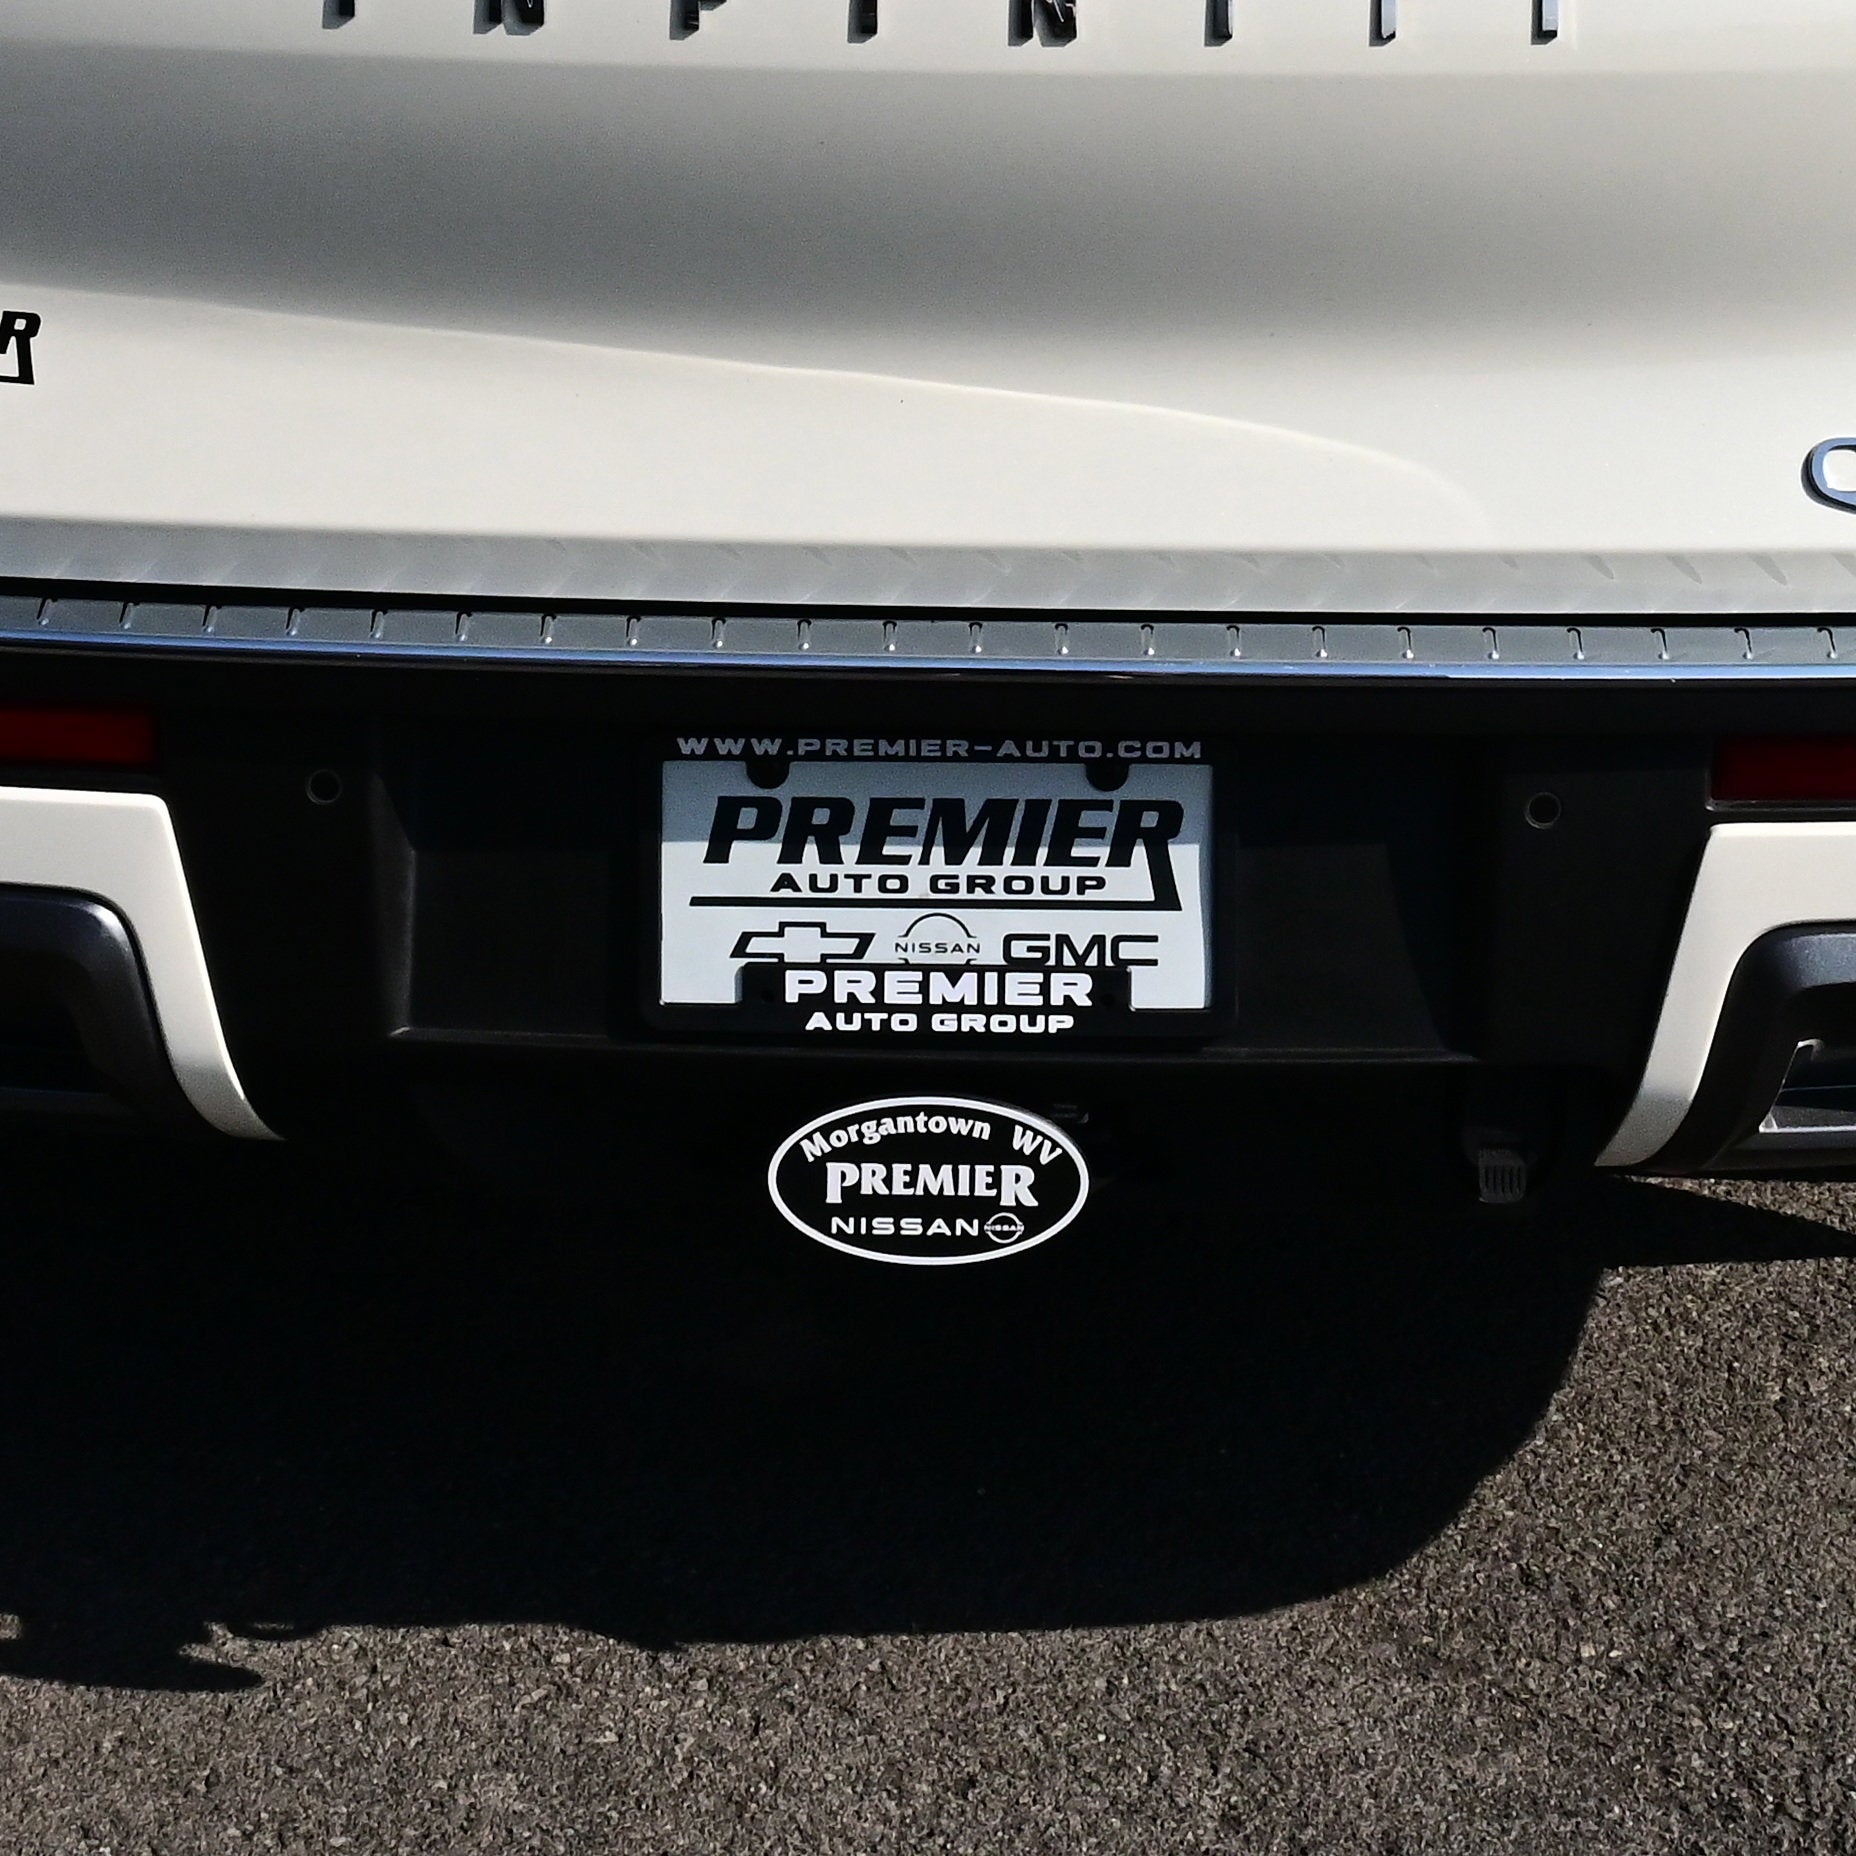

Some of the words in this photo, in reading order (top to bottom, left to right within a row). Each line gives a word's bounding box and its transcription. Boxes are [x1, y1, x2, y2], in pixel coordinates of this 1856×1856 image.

[676, 737, 1203, 759] WWW.PREMIER-AUTO.COM
[702, 795, 1186, 889] PREMIER
[769, 872, 910, 896] AUTO
[928, 873, 1108, 896] GROUP
[894, 940, 981, 956] NISSAN
[1001, 932, 1160, 967] GMC
[784, 969, 1093, 1007] PREMIER
[804, 1011, 919, 1033] AUTO
[931, 1012, 1075, 1034] GROUP
[799, 1111, 992, 1163] Morgantown
[1011, 1124, 1063, 1167] WV
[825, 1162, 1039, 1207] PREMIER
[830, 1216, 979, 1237] NISSAN
[984, 1223, 1025, 1232] NISSAN
